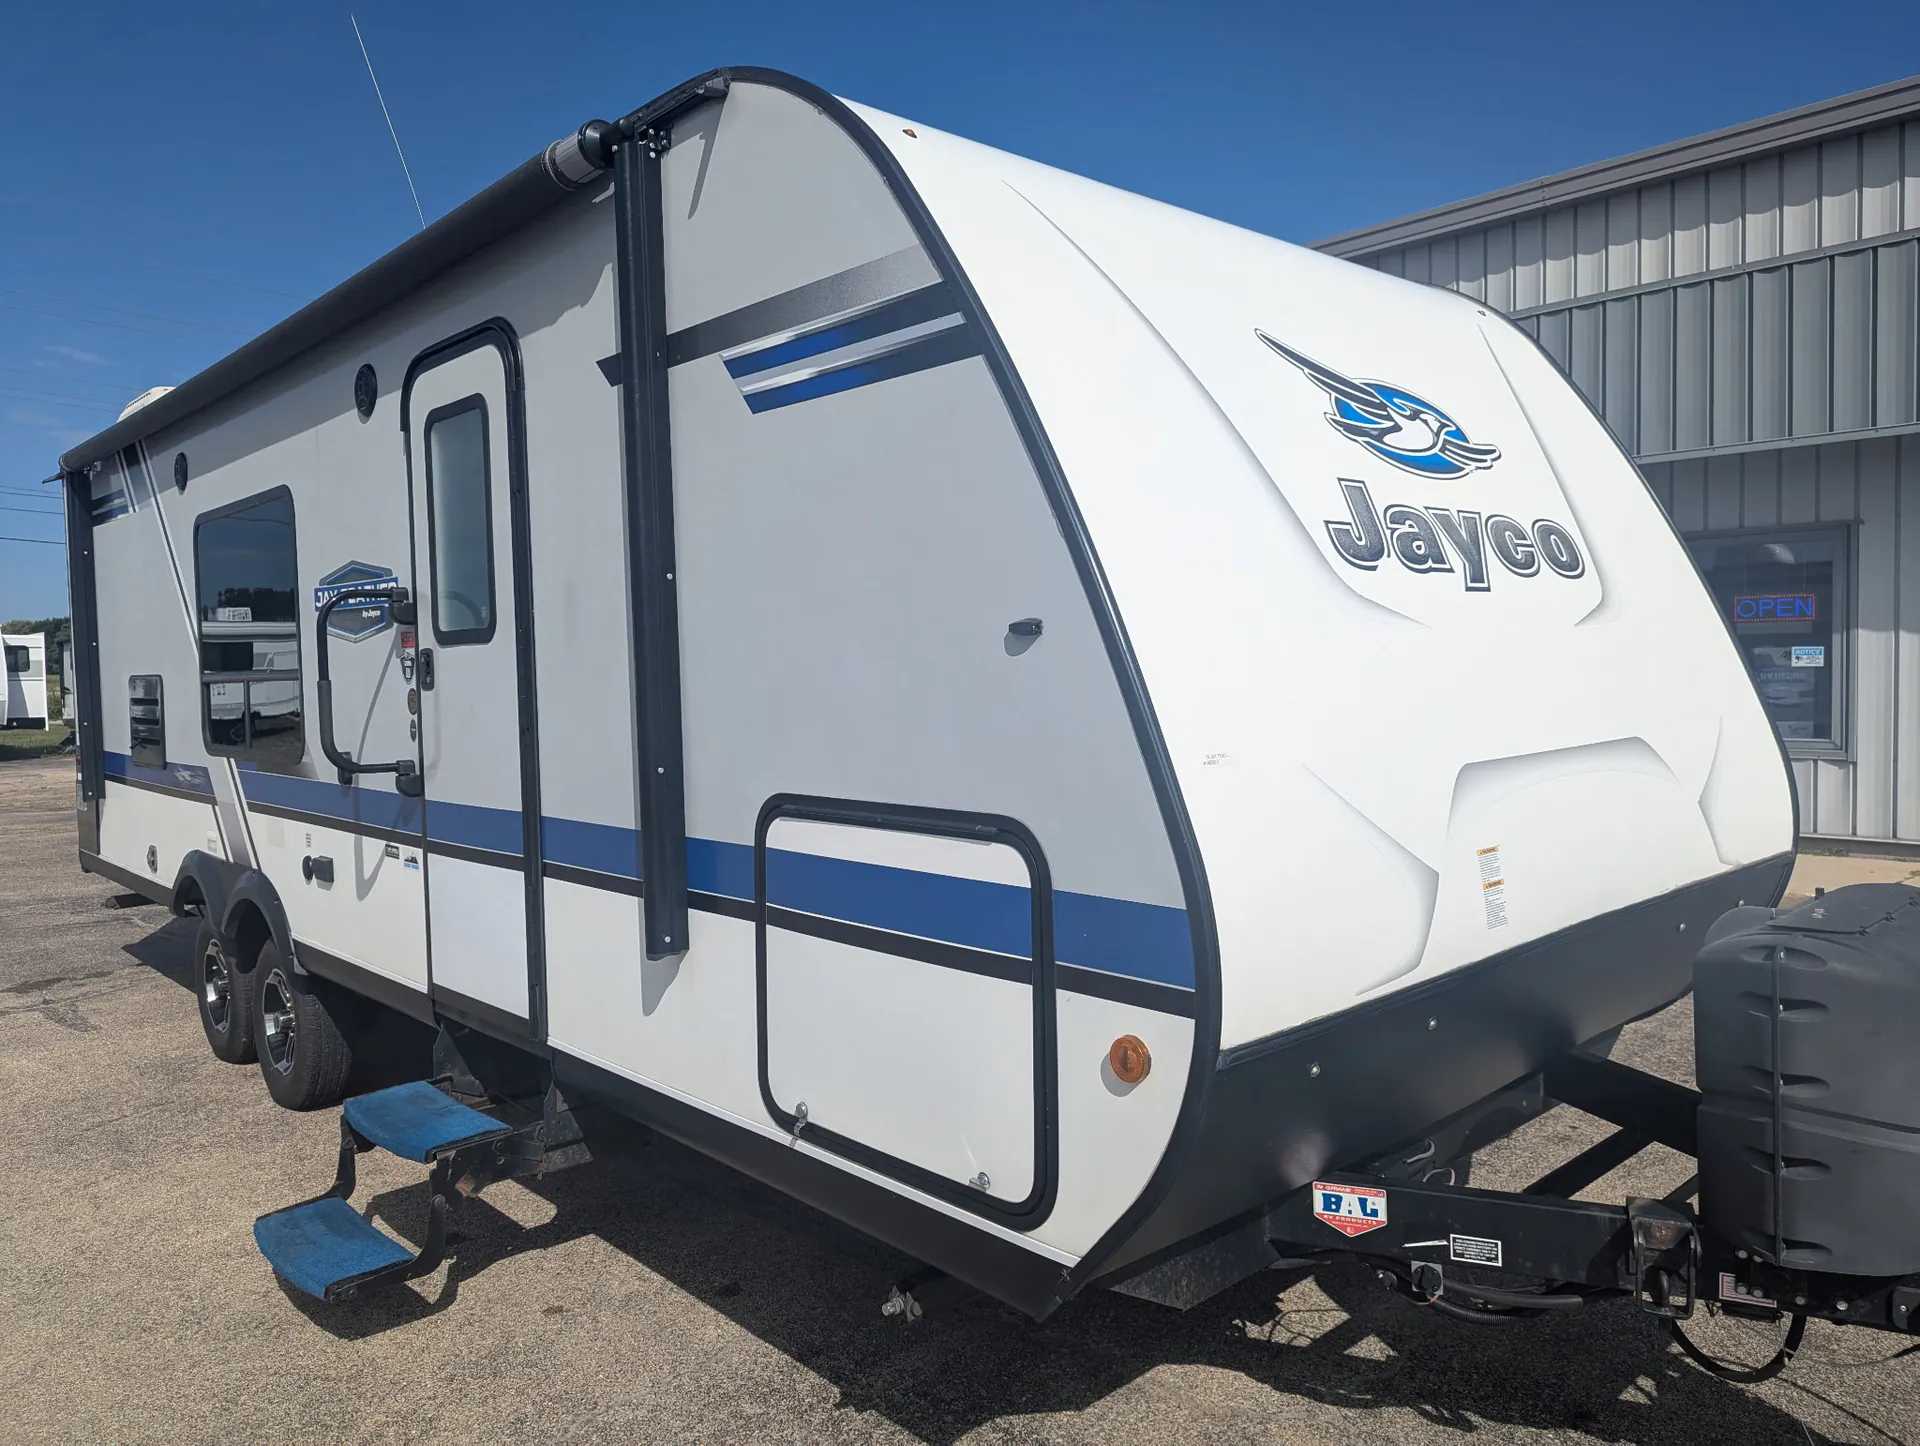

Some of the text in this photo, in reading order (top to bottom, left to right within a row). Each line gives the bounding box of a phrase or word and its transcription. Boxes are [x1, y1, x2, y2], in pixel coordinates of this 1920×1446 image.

[1323, 477, 1585, 592] Jayco
[1737, 597, 1813, 618] OPEN
[1795, 648, 1821, 656] NOTICE
[1321, 1192, 1379, 1218] BAL
[1335, 1215, 1377, 1225] PRODUCTS
